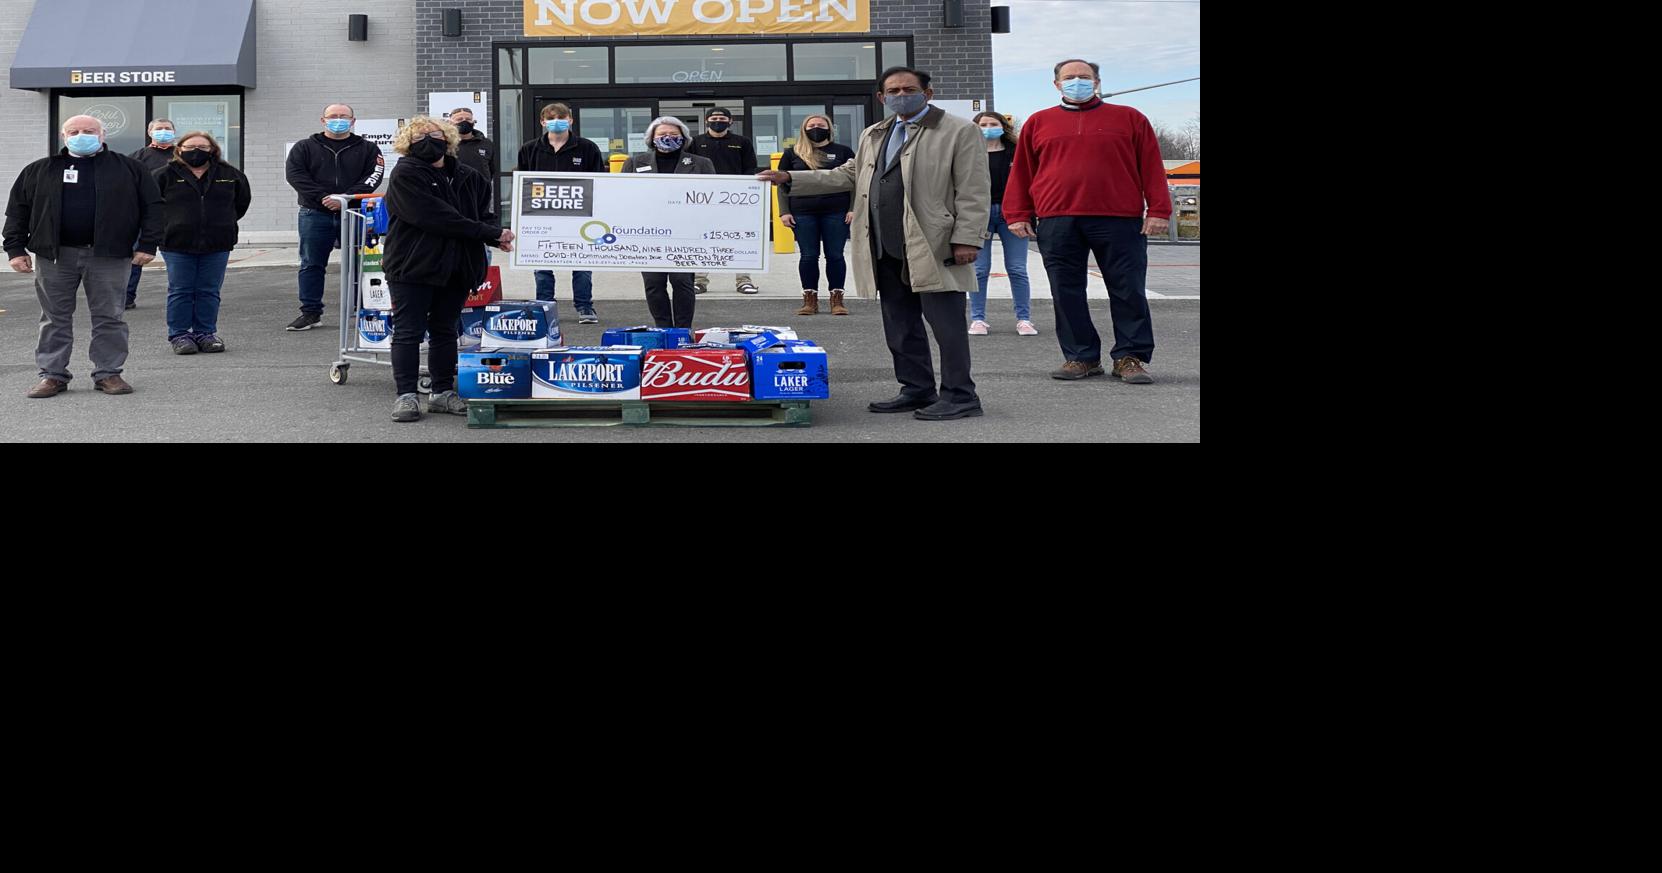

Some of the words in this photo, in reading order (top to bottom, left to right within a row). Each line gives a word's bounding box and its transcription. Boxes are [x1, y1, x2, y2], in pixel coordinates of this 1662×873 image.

[534, 0, 680, 26] NOW
[693, 0, 858, 24] OPEN
[71, 70, 115, 84] BEER
[119, 71, 176, 83] STORE
[672, 70, 723, 83] OPEN
[531, 182, 584, 199] BEER
[685, 190, 714, 205] NOV
[719, 191, 760, 205] 2020
[531, 198, 584, 210] STORE
[611, 225, 673, 235] foundation
[537, 239, 584, 250] FIFTEEN
[709, 246, 735, 254] THREE
[666, 253, 712, 261] CARLETON
[489, 317, 538, 332] LAKEPORT
[548, 360, 625, 382] LAKEPORT
[477, 372, 515, 385] Blue
[774, 376, 808, 387] LAKER
